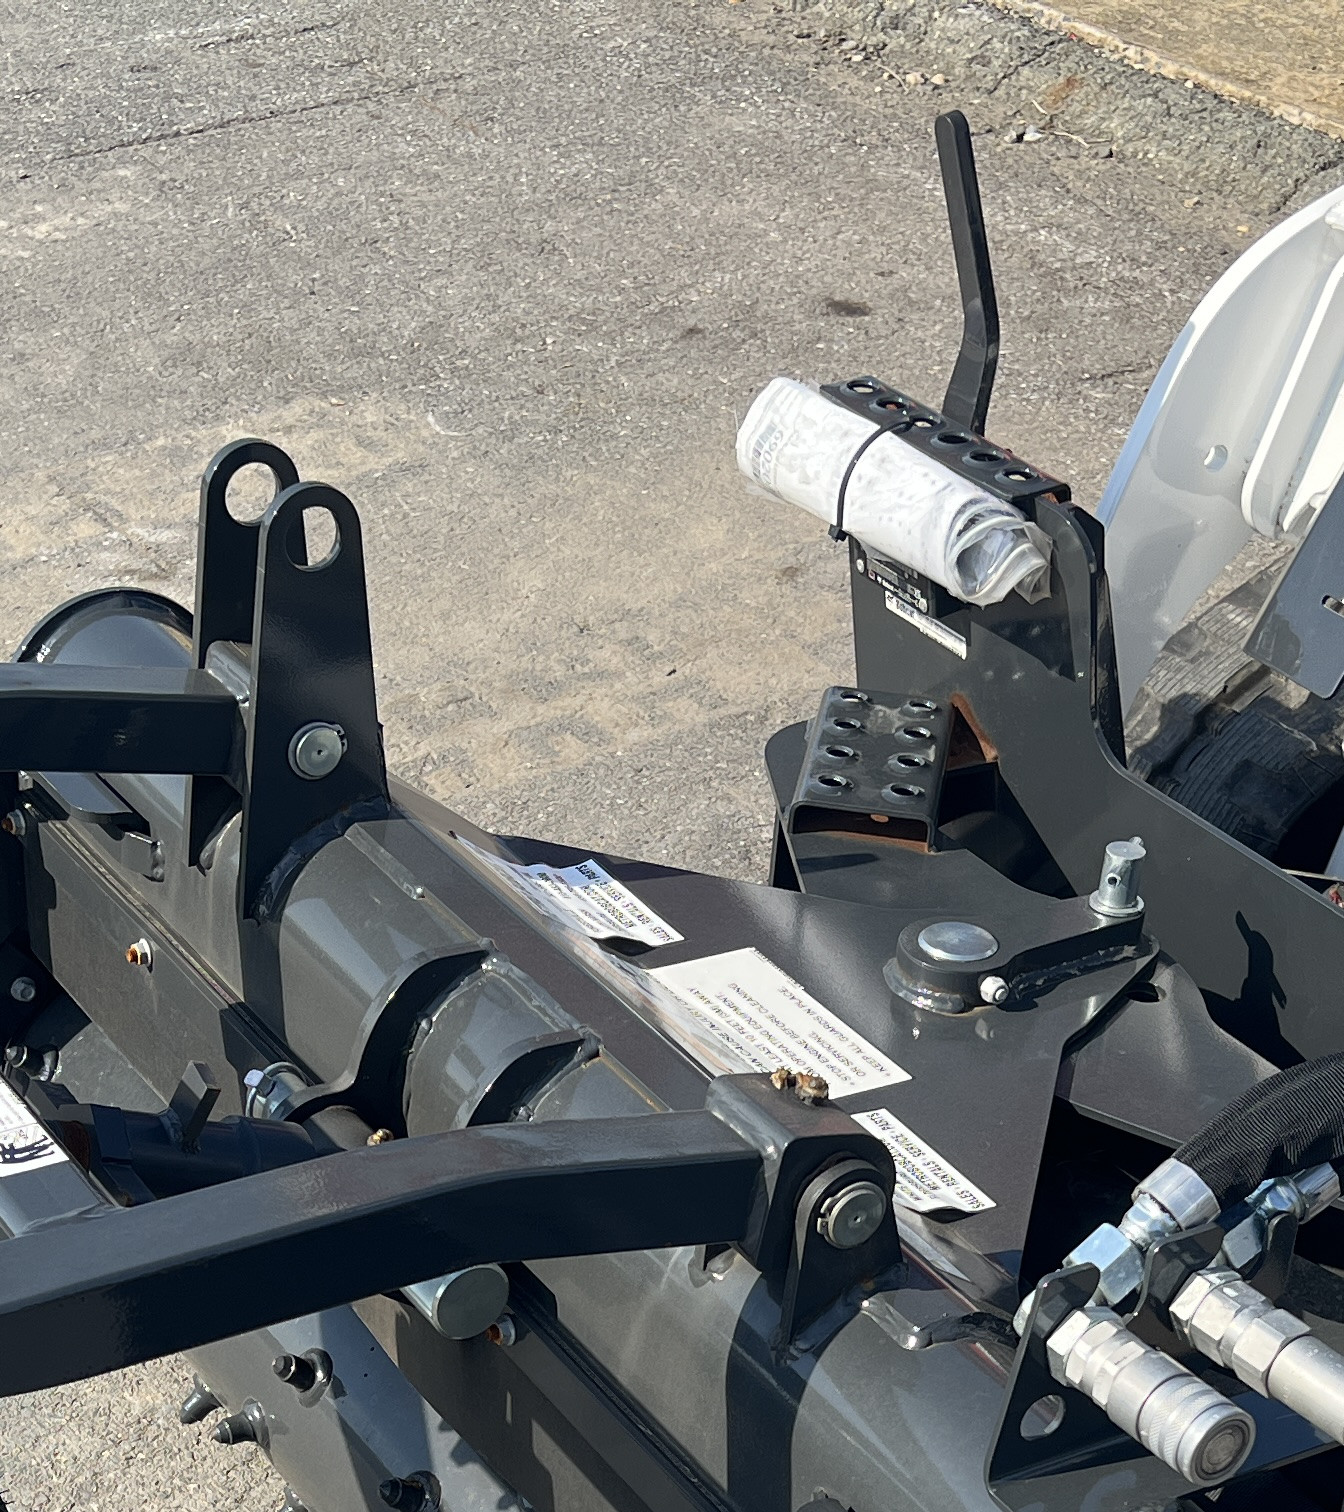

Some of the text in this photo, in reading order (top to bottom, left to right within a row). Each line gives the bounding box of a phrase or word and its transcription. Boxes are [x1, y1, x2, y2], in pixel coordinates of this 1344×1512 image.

[687, 986, 714, 1007] AWAY
[726, 1017, 748, 1036] FEET
[727, 982, 851, 1081] STOP ENGINE BEFORE CLEANING
[813, 1014, 848, 1042] GUARDS
[754, 1042, 784, 1065] LEAST
[760, 1029, 805, 1066] OPERATING
[845, 1041, 864, 1055] ALL
[862, 1054, 886, 1073] KEEP
[866, 1112, 895, 1131] PARTS
[891, 1133, 926, 1158] SERVICE
[922, 1160, 959, 1187] RENTALS
[956, 1190, 985, 1209] SALES
